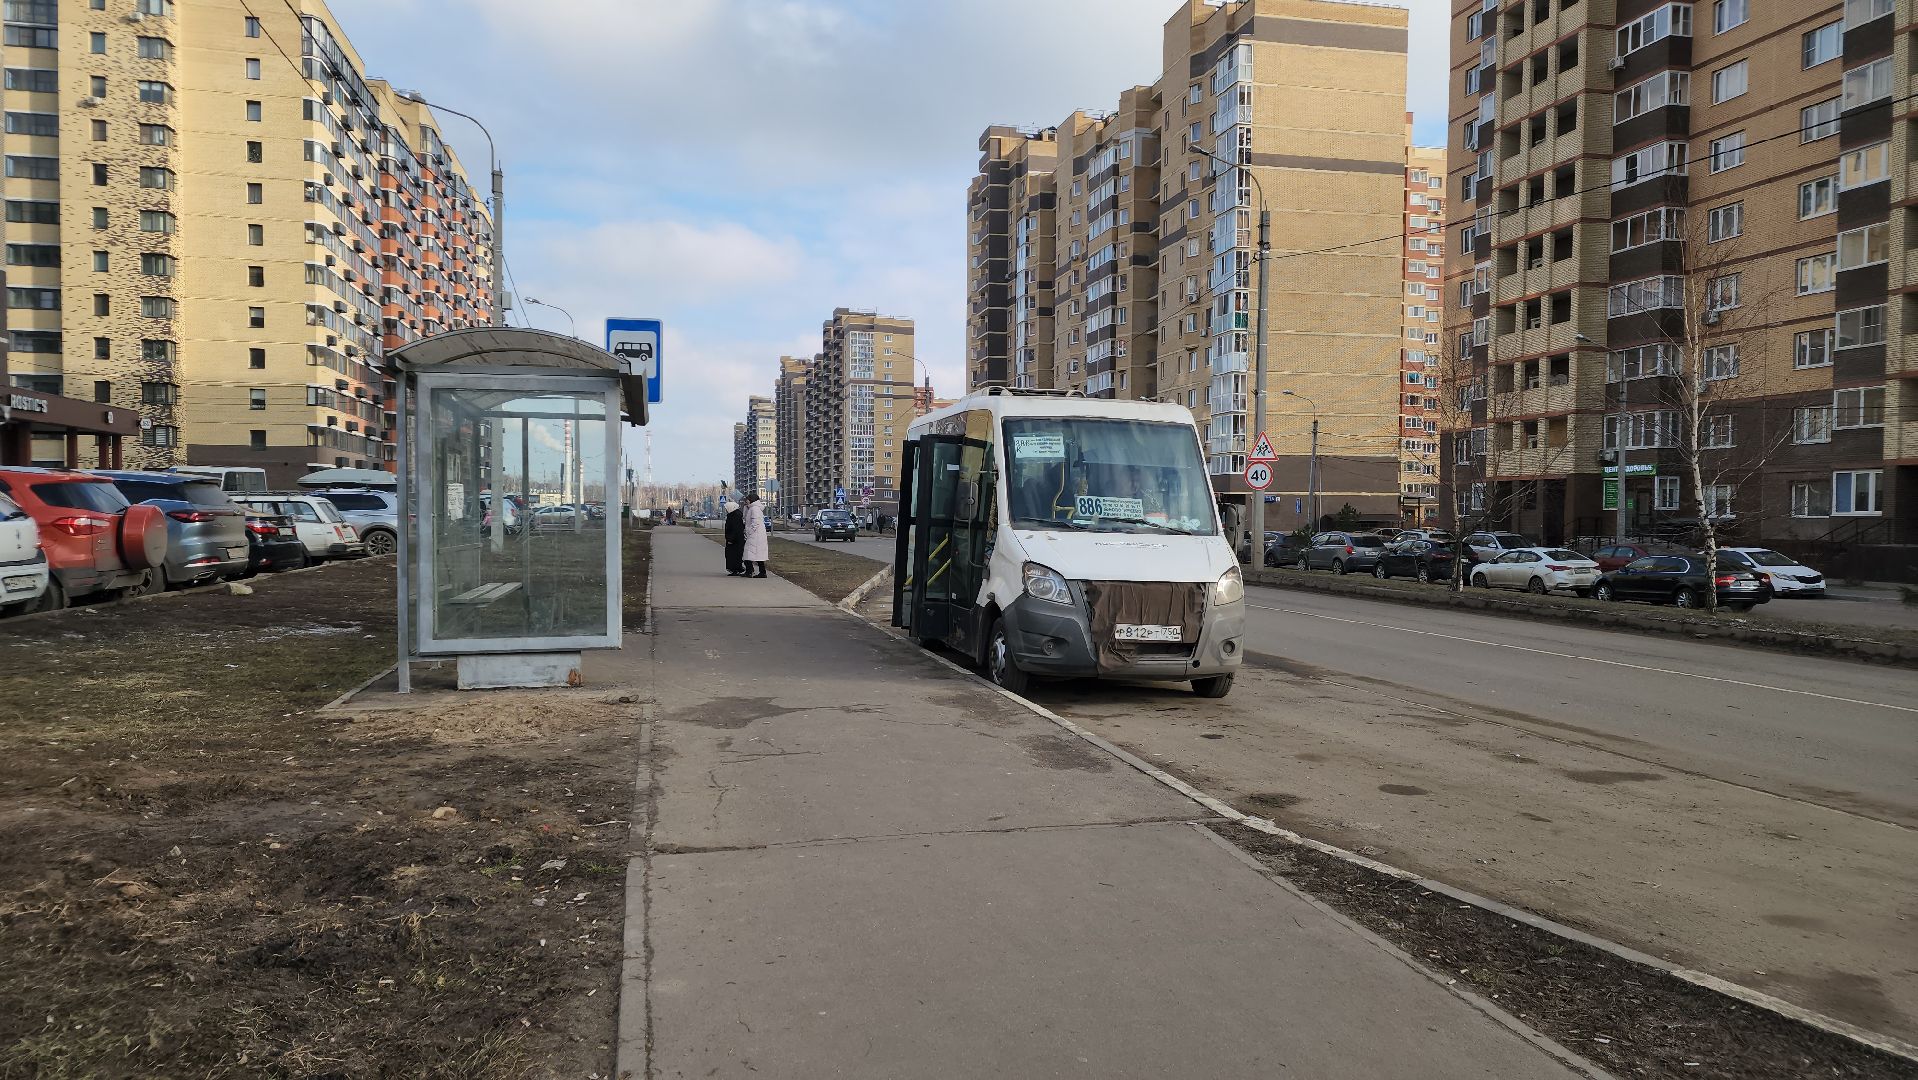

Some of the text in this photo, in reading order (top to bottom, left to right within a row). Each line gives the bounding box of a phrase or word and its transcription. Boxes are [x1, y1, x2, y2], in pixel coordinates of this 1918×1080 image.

[10, 394, 48, 414] ROSTIC'S
[1250, 469, 1267, 481] 40
[1079, 497, 1103, 516] 886
